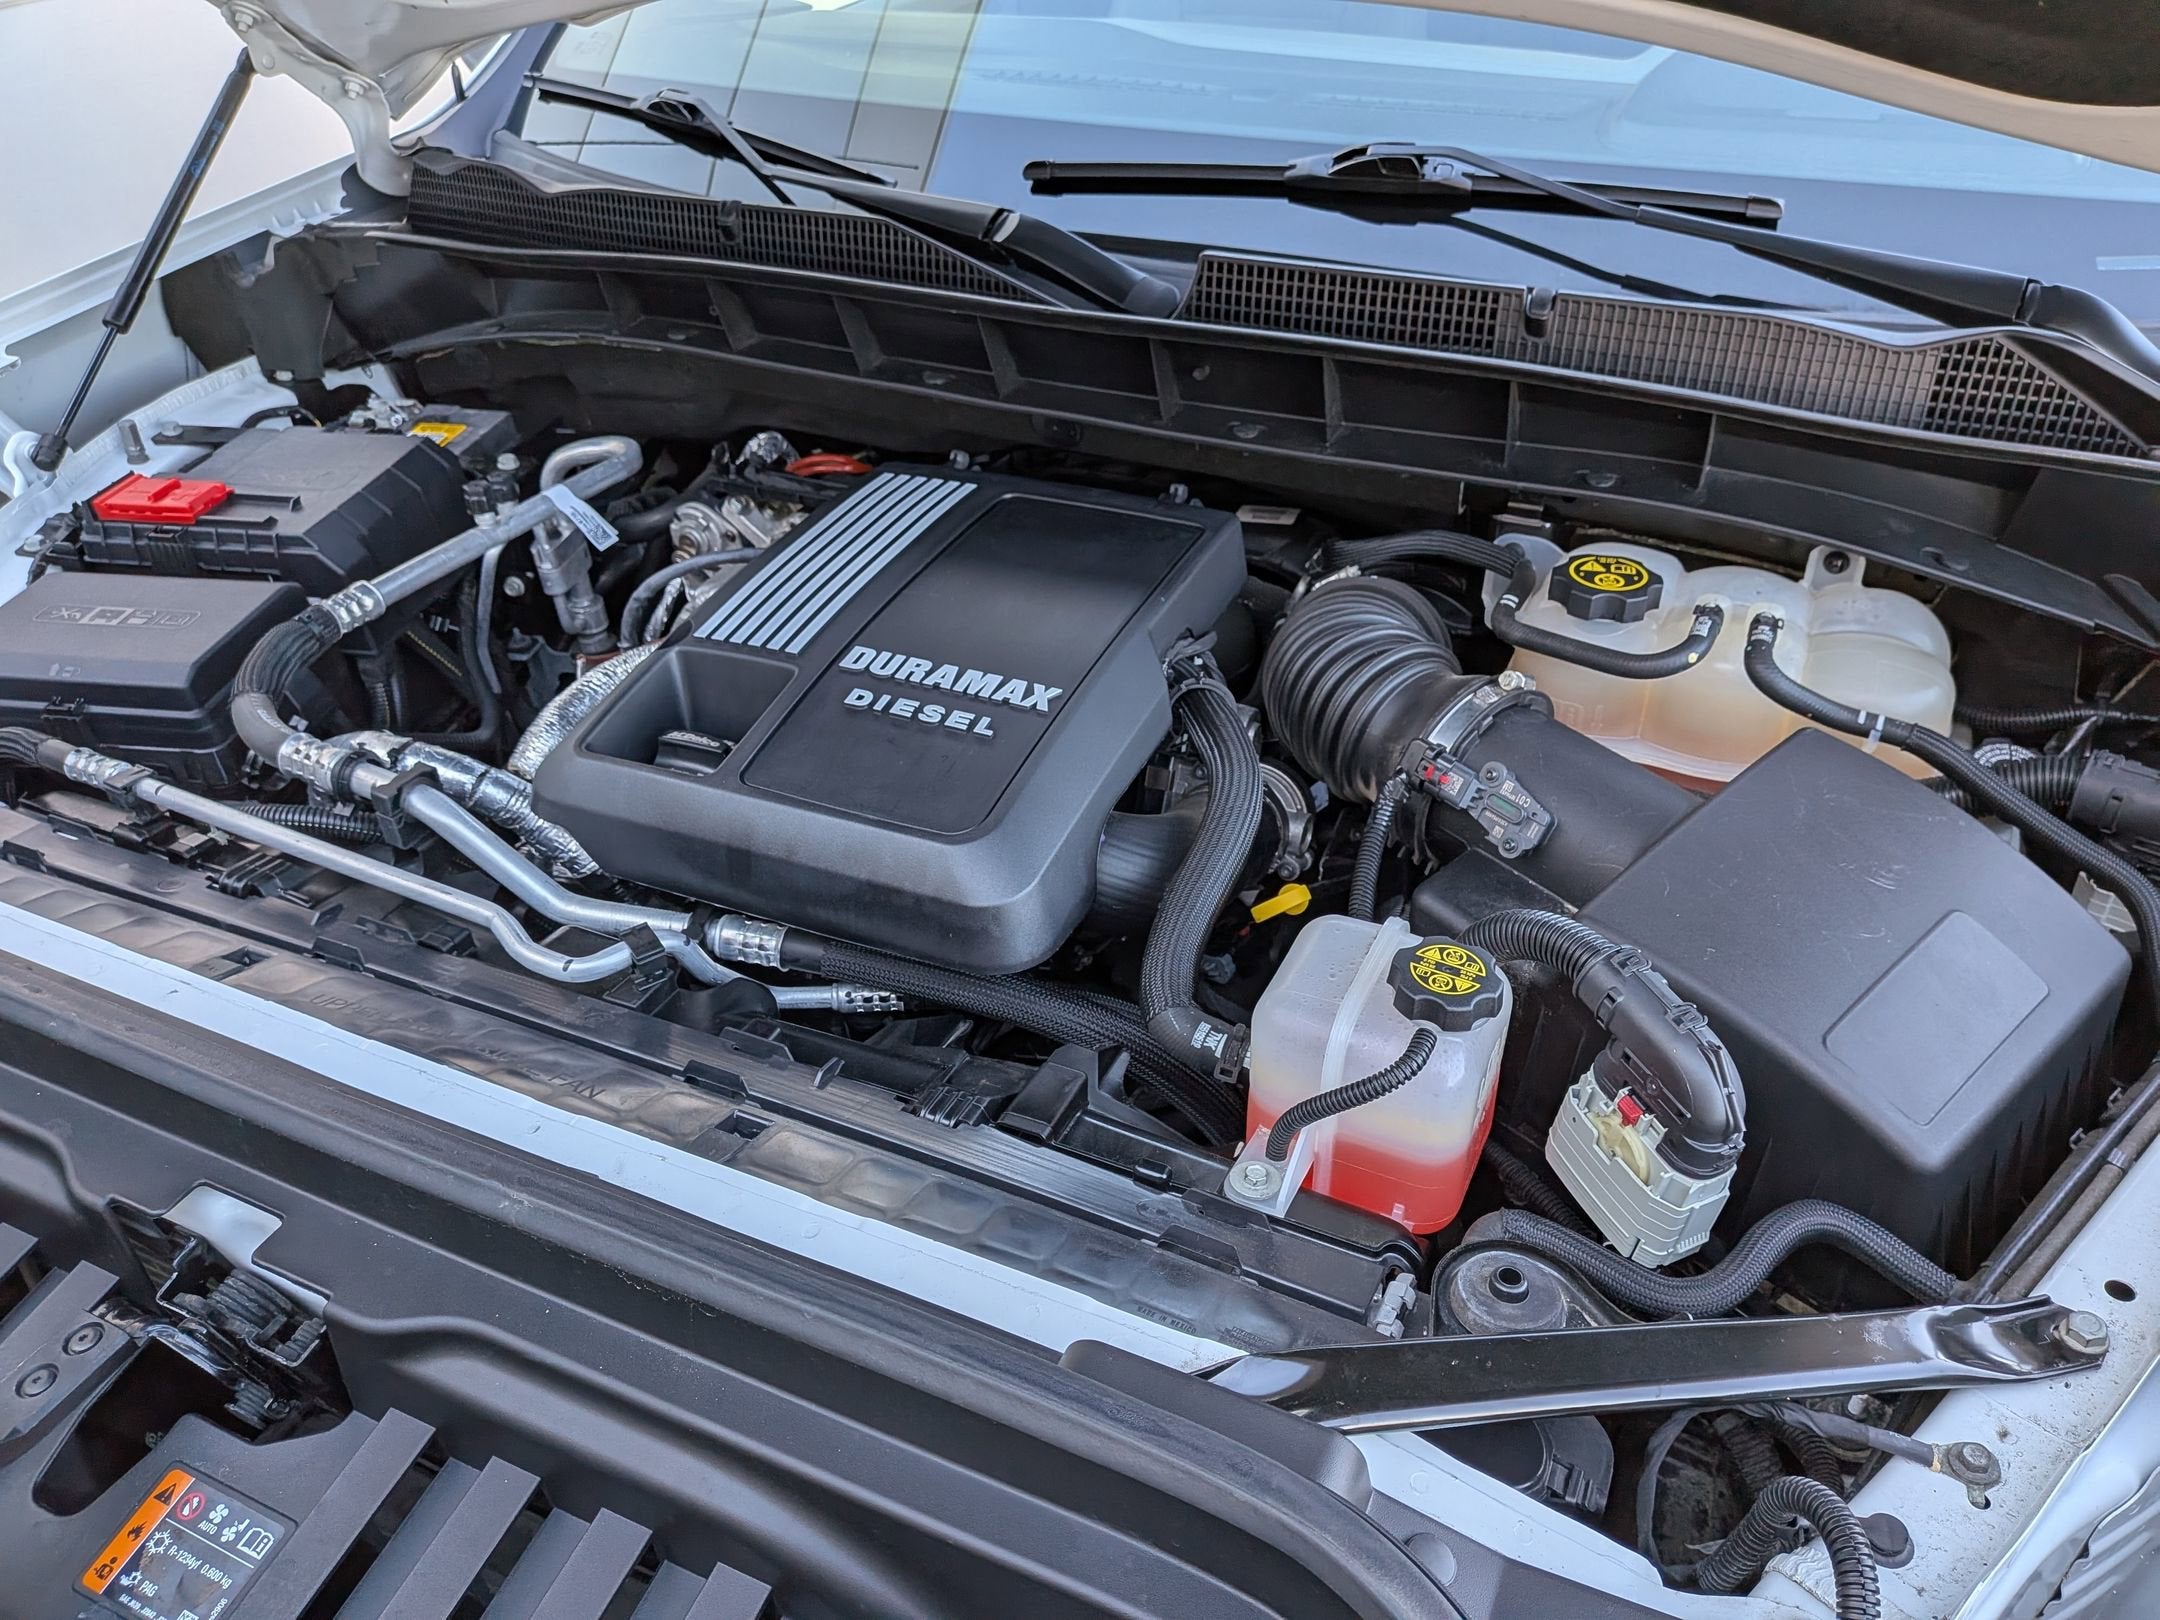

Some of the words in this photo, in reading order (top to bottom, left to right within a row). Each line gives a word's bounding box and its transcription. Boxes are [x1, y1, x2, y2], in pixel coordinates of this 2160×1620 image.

[838, 645, 1063, 713] DURAMAX
[843, 687, 995, 737] DIESEL
[1159, 1315, 1167, 1323] IN
[1170, 1319, 1197, 1334] MEXICO
[198, 1520, 218, 1535] AUTO
[167, 1545, 203, 1571] R-1234yf
[200, 1564, 224, 1583] 0.600
[221, 1574, 233, 1590] kg
[139, 1580, 159, 1597] PAG
